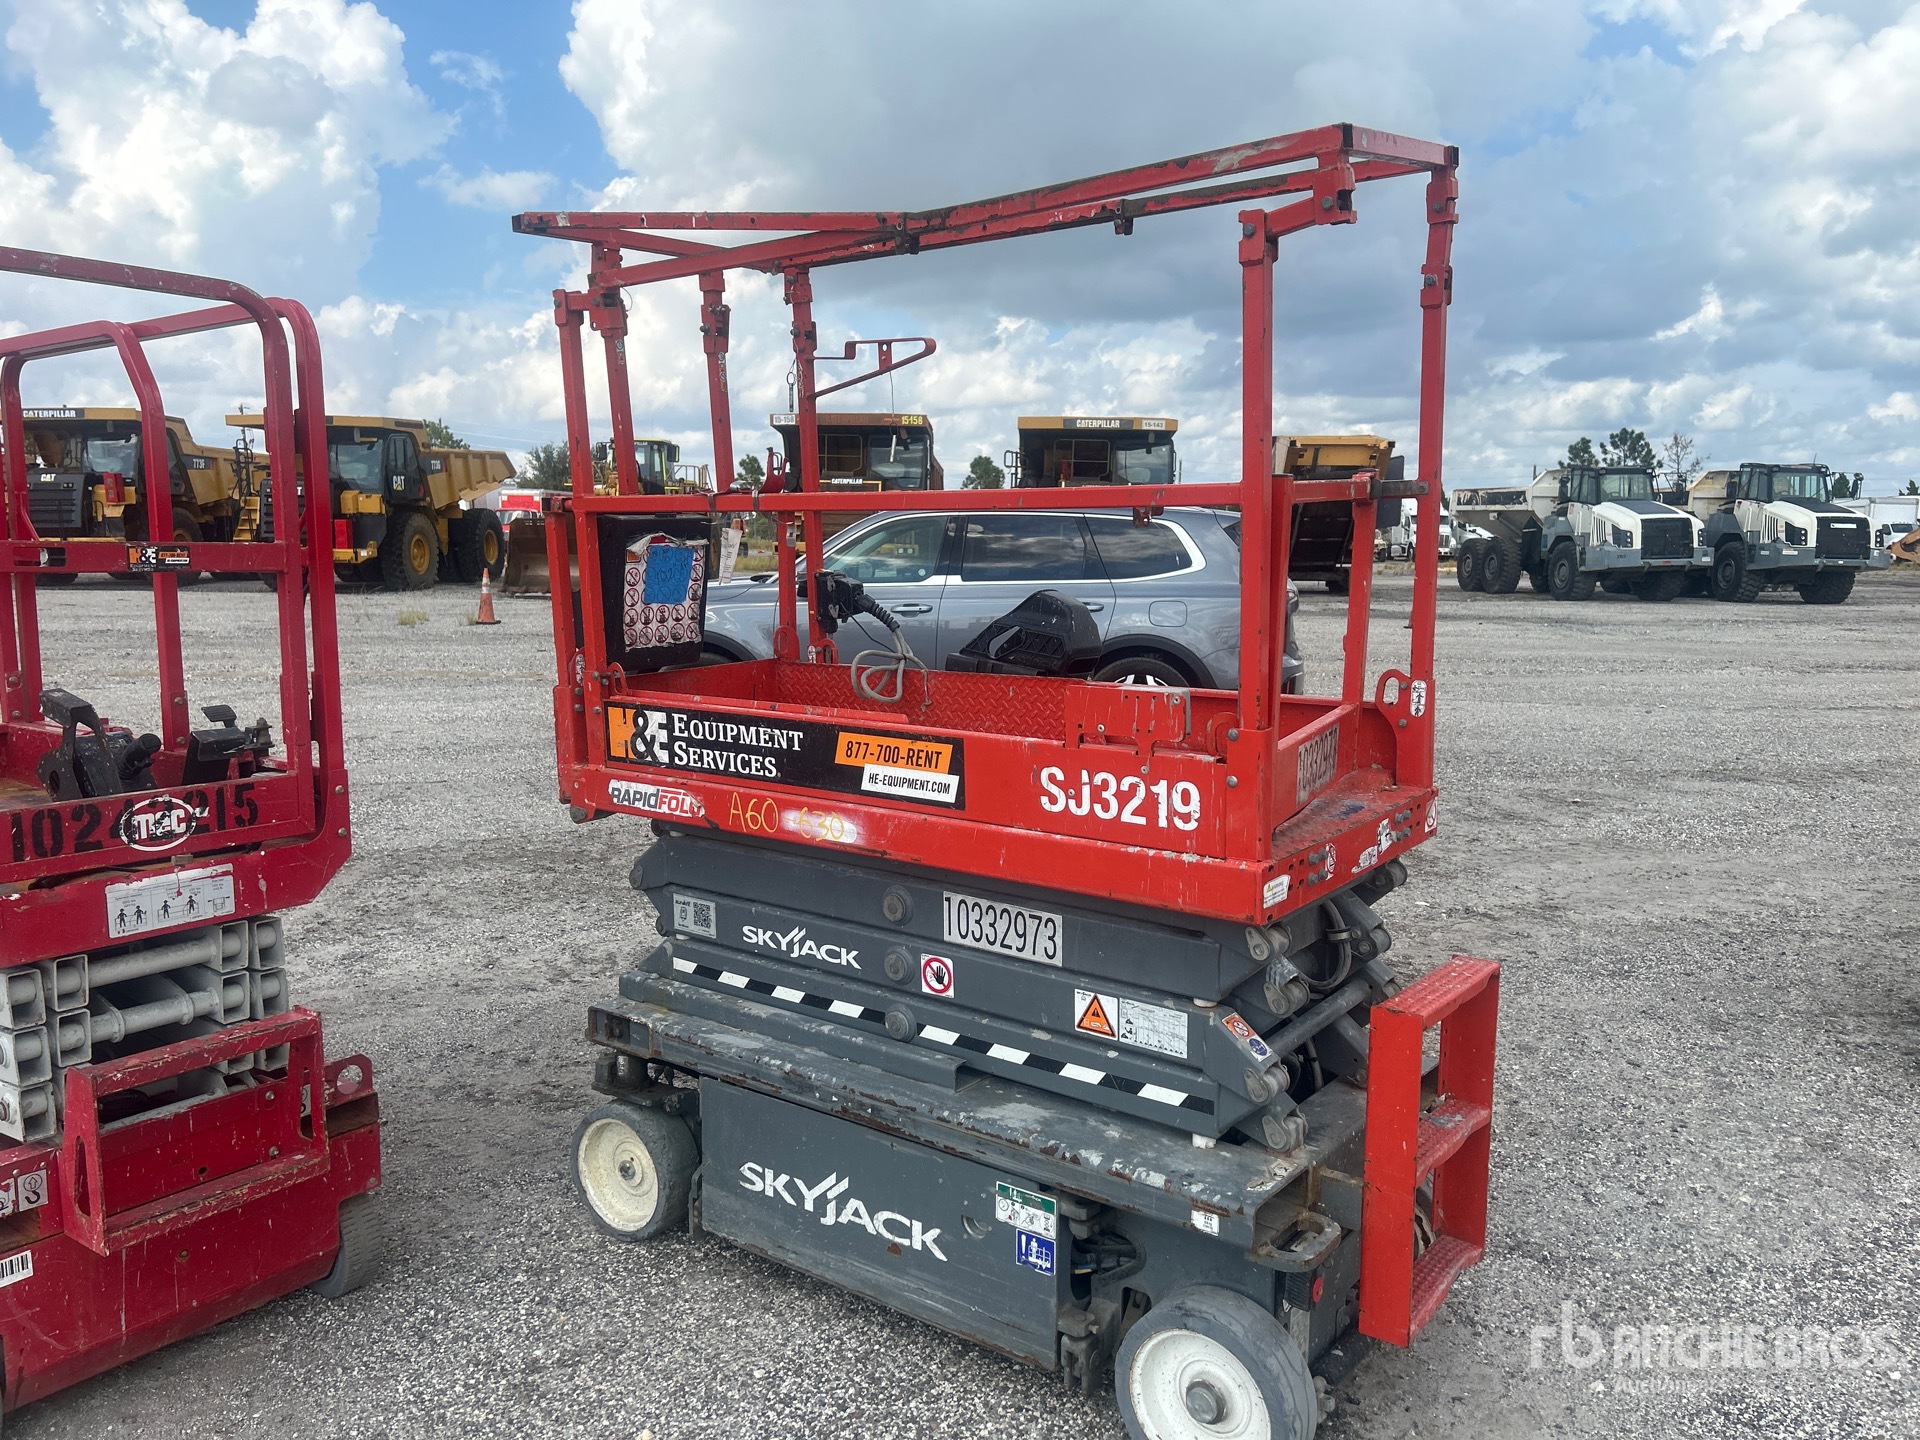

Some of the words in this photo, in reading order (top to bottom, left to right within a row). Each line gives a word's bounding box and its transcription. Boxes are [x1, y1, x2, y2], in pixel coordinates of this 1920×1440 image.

[22, 409, 76, 418] CATERPILLAR
[774, 415, 795, 424] 15-158
[901, 415, 923, 425] 15-158
[1076, 419, 1121, 429] CATERPILLAR
[1144, 421, 1164, 429] 15-143
[192, 458, 206, 469] 773F
[40, 473, 57, 482] CAT
[392, 475, 405, 491] CAT
[129, 547, 157, 564] H&E
[607, 706, 670, 764] H&E
[671, 713, 804, 751] EQUIPMENT
[845, 740, 943, 770] 877-700-RENT
[868, 772, 951, 795] HE-EQUIPMENT.COM
[1040, 766, 1201, 831] SJ3219
[944, 896, 1058, 961] 10332973
[742, 925, 862, 970] SKYJACK
[738, 1160, 949, 1263] SKYJACK
